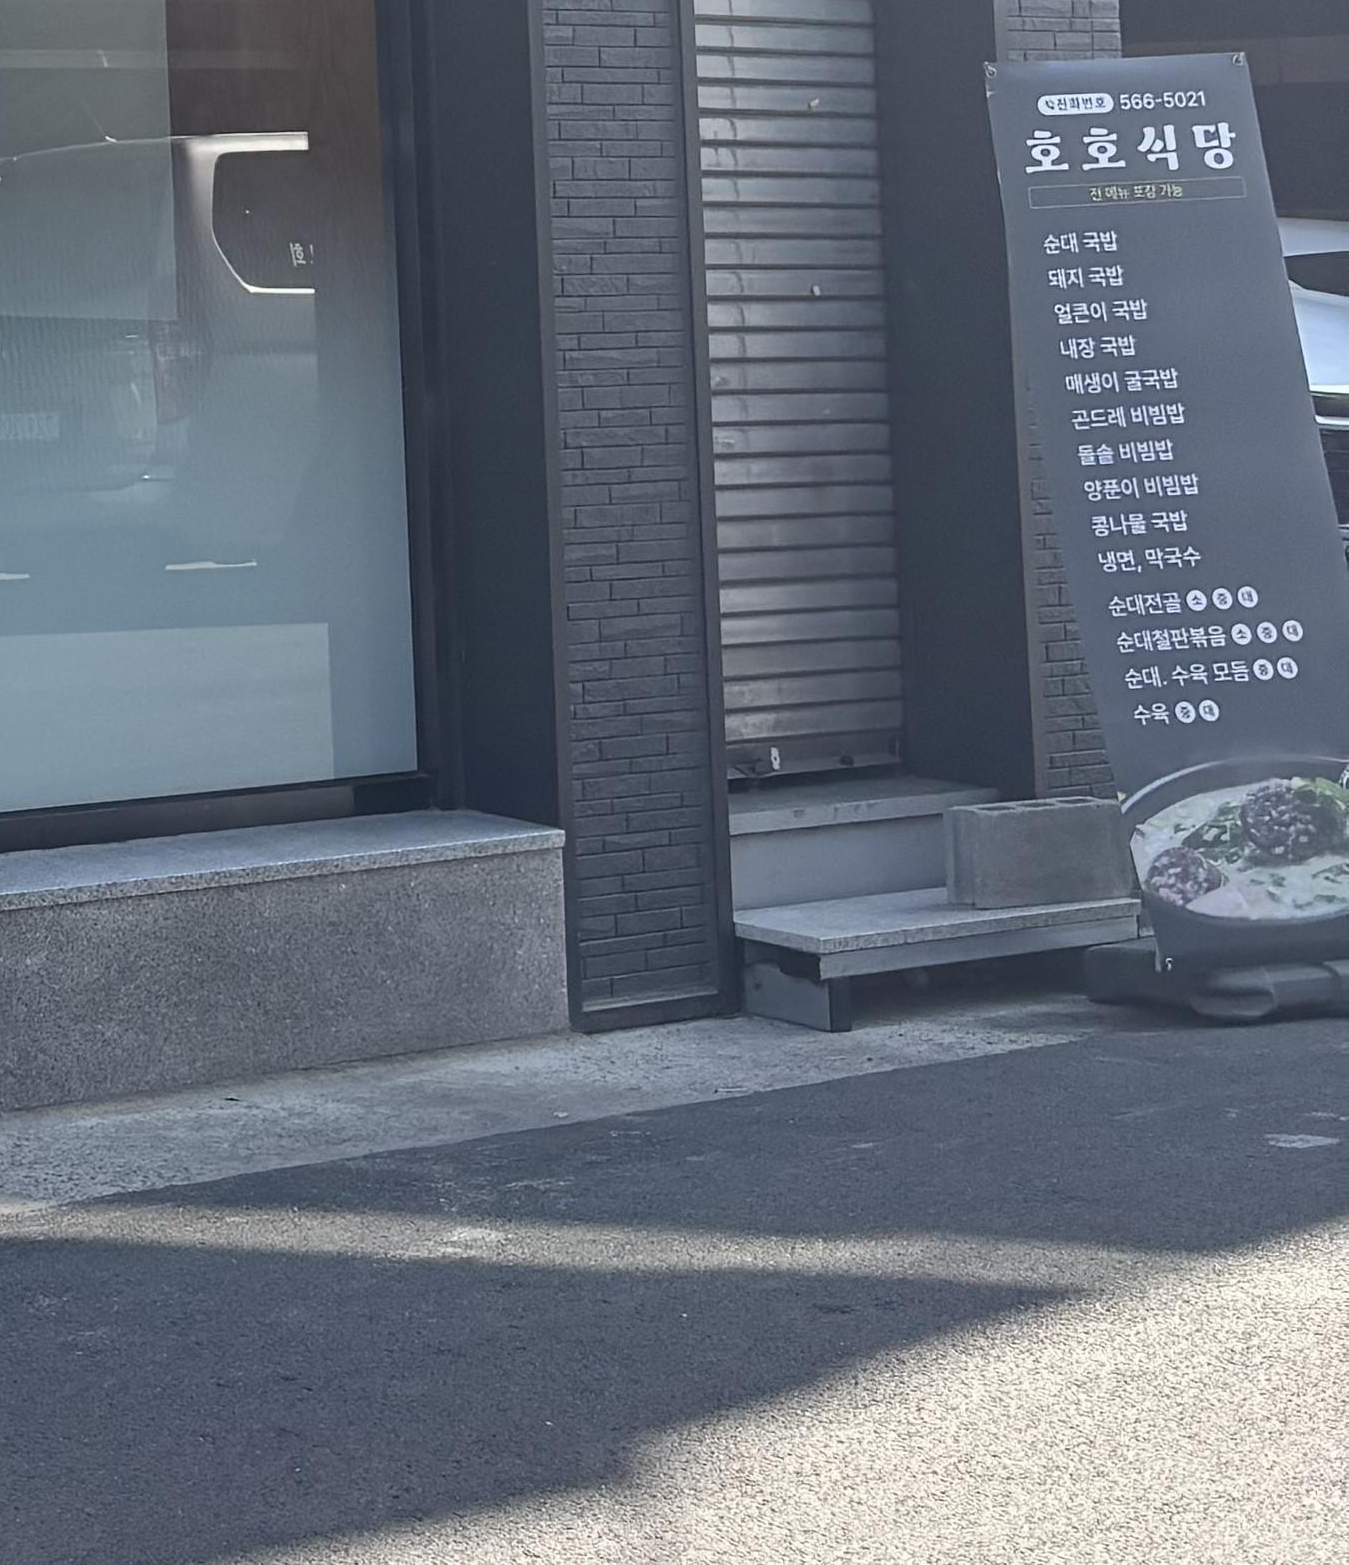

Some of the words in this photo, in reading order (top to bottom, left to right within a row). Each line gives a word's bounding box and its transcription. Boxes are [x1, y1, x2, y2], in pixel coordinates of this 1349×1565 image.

[1119, 91, 1206, 110] 566-5021
[1025, 122, 1236, 174] 호호식당
[1043, 232, 1079, 255] 순대
[1082, 230, 1117, 253] 국밥
[1048, 266, 1084, 289] 돼지
[1088, 265, 1124, 287] 국밥
[1054, 301, 1108, 325] 얼큰이
[1111, 298, 1148, 321] 국밥
[1060, 336, 1096, 360] 내장
[1100, 334, 1137, 357] 국밥
[1065, 371, 1120, 395] 매생이
[1124, 367, 1179, 391] 굴국밥
[1070, 406, 1127, 430] 곤드레
[1130, 402, 1185, 425] 비빔밥
[1118, 438, 1174, 463] 비빔밥
[1083, 477, 1140, 502] 양푼이
[1144, 473, 1199, 497] 비빔밥
[1091, 512, 1147, 537] 콩나물
[1151, 509, 1188, 533] 국밥
[1097, 549, 1142, 573] 냉면,
[1144, 546, 1201, 569] 막국수
[1108, 592, 1182, 617] 순대전골
[1116, 624, 1226, 653] 순대철판볶음
[1171, 663, 1209, 687] 수육
[1212, 660, 1250, 682] 모듬
[1133, 702, 1170, 726] 수육
